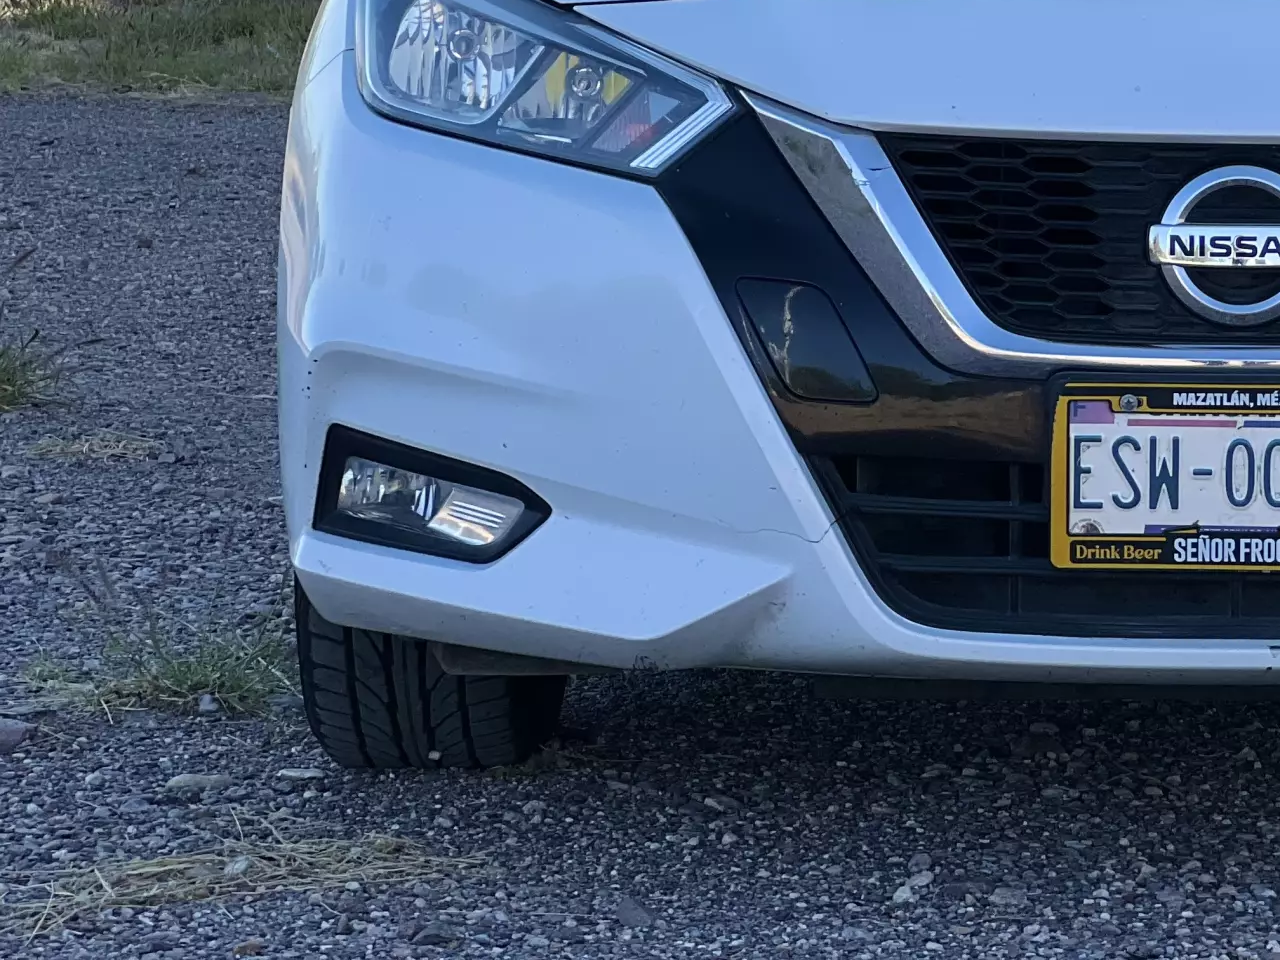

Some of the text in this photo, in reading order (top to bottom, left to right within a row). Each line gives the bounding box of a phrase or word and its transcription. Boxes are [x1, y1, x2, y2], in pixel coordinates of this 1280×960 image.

[1172, 390, 1254, 408] MAZATLÁN,
[1075, 544, 1162, 560] Drink Beer
[1173, 534, 1237, 563] SEÑOR
